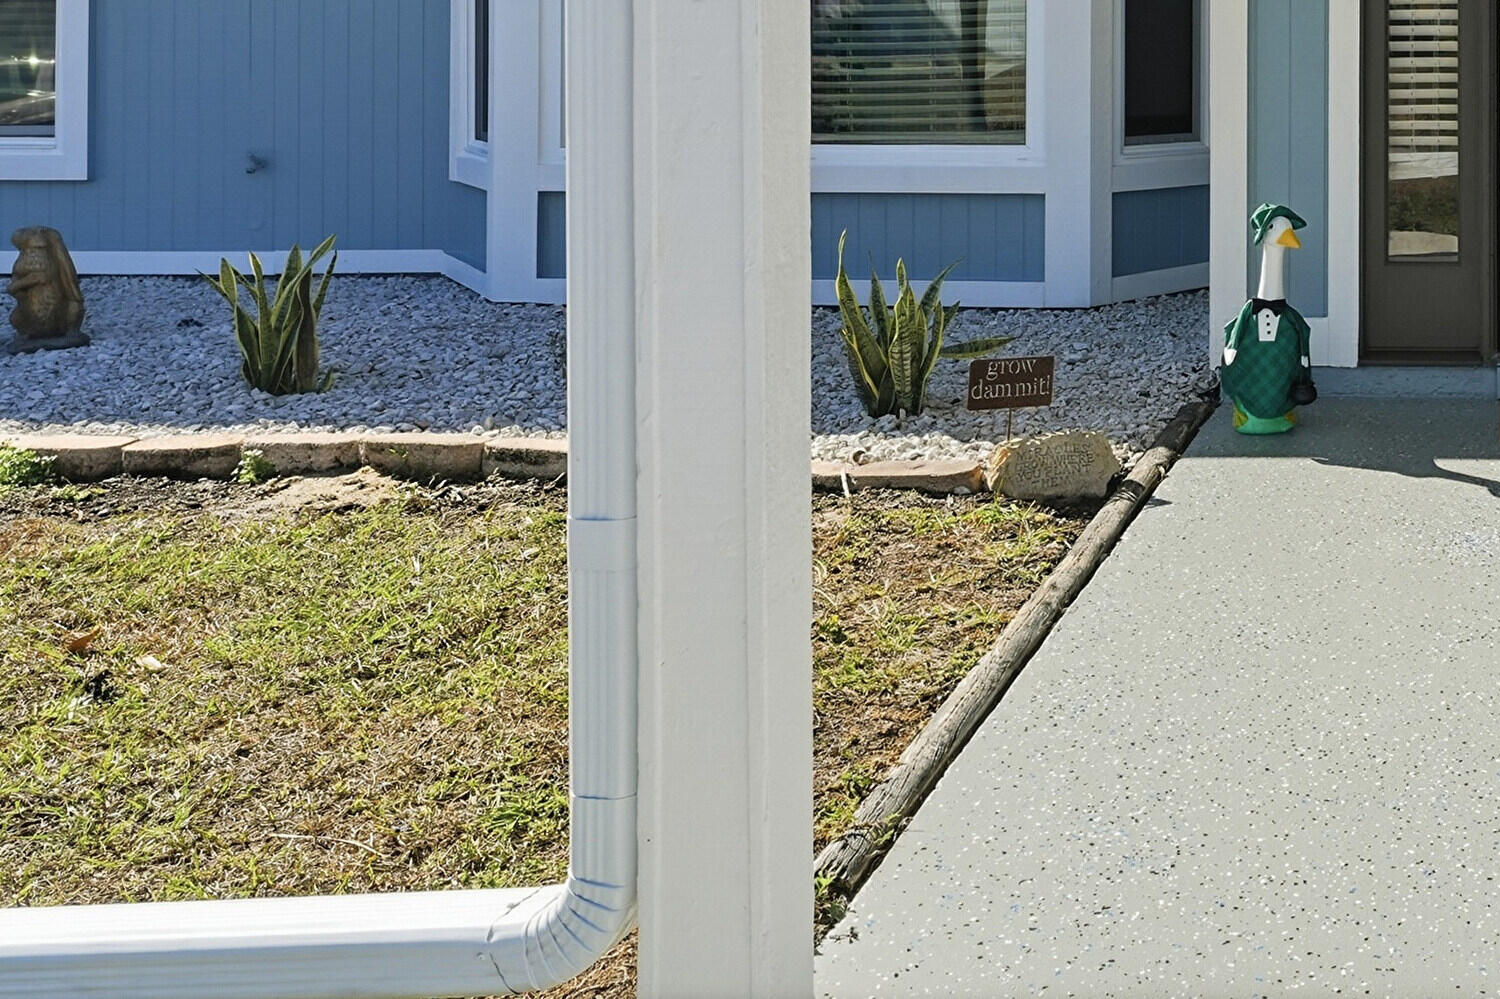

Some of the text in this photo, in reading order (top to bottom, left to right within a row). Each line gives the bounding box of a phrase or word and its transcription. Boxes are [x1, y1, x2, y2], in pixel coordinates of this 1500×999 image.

[986, 359, 1036, 381] grow
[971, 374, 1051, 400] dammit!
[1053, 453, 1095, 466] WHERE
[1016, 469, 1041, 482] YOU
